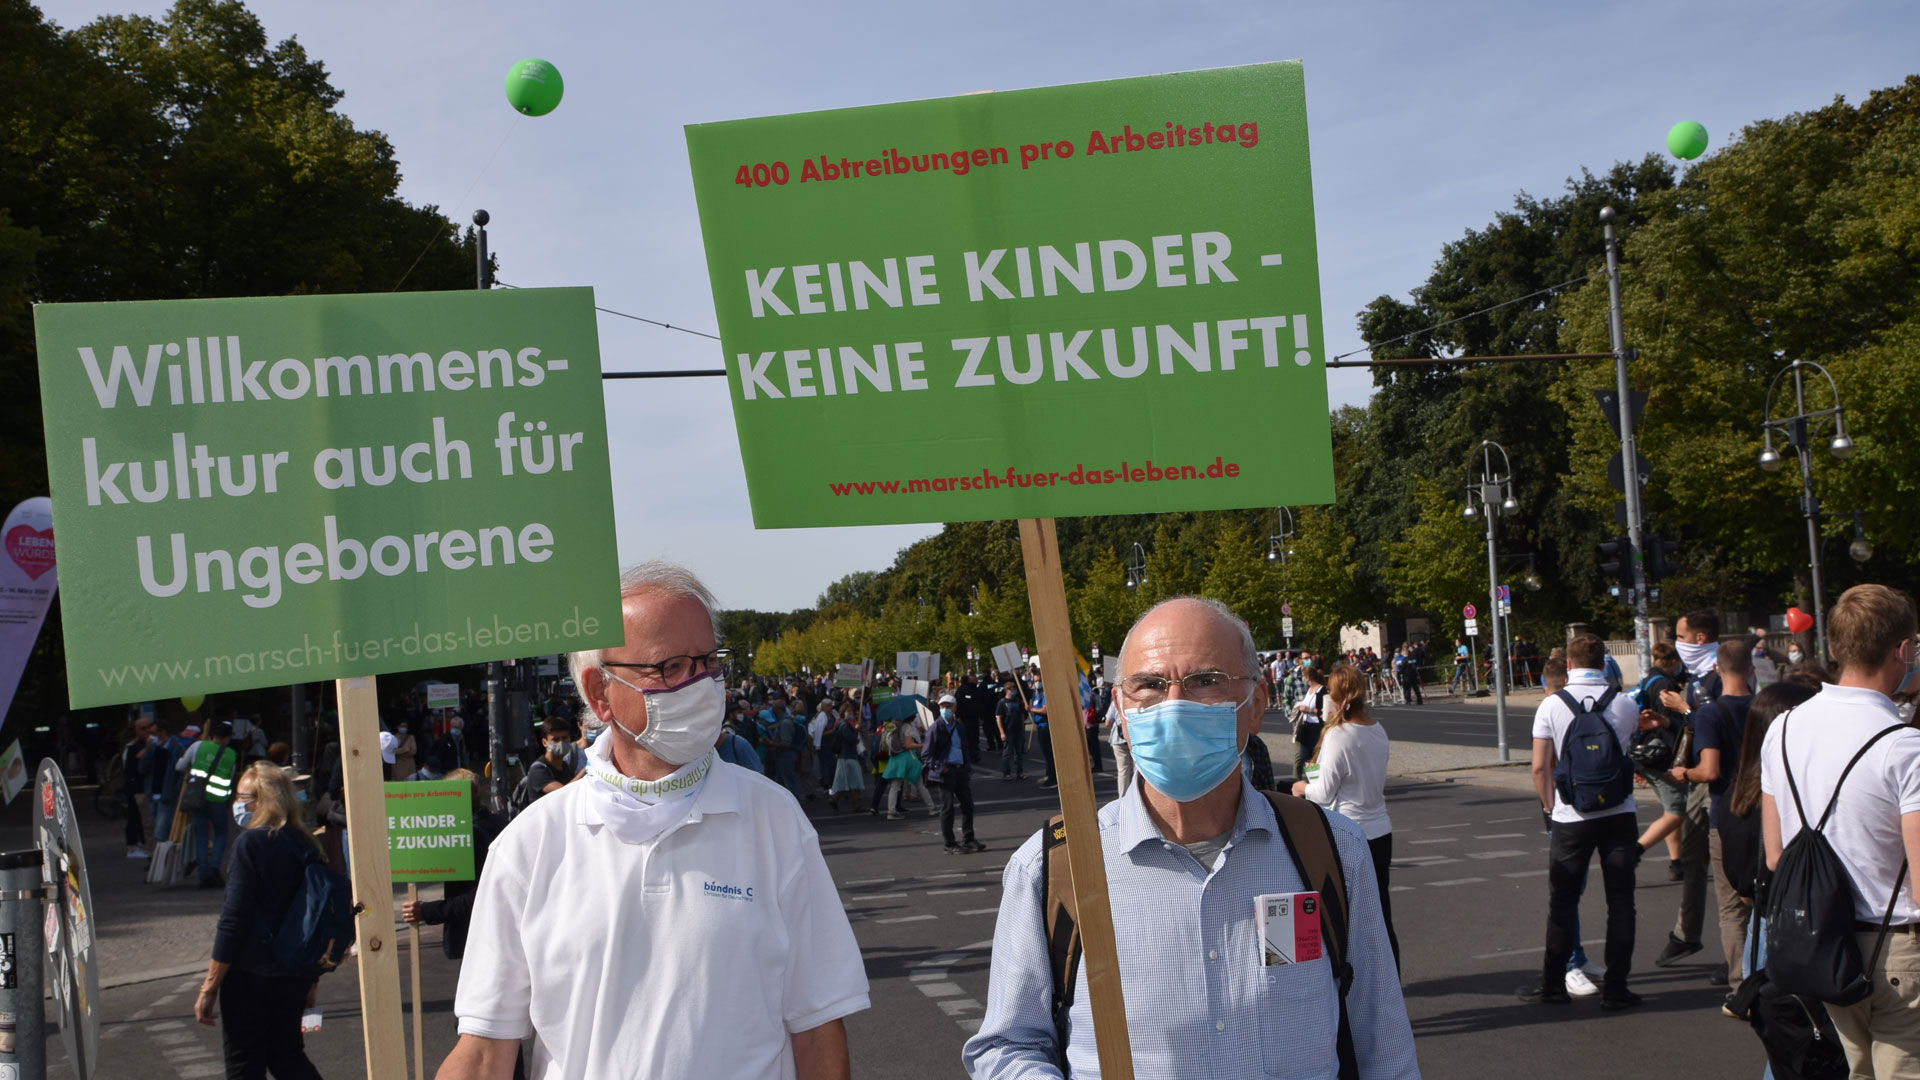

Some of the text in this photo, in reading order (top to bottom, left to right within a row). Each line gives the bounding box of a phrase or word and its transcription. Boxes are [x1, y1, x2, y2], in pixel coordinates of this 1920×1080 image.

[734, 121, 1260, 188] 400 Abtreibungen pro Arbeitstag
[744, 230, 1284, 319] KEINE KINDER -
[77, 335, 570, 409] Willkommens-
[736, 313, 1314, 402] KEINE ZUKUNFT!
[82, 411, 585, 508] kultur auch für
[829, 456, 1241, 498] www.marsch-fuer-das-leben.de
[135, 515, 556, 610] Ungeborene
[97, 605, 602, 689] www.marsch-fuer-das-leben.de
[396, 834, 471, 849] ZUKUNFT!
[400, 814, 456, 829] KINDER
